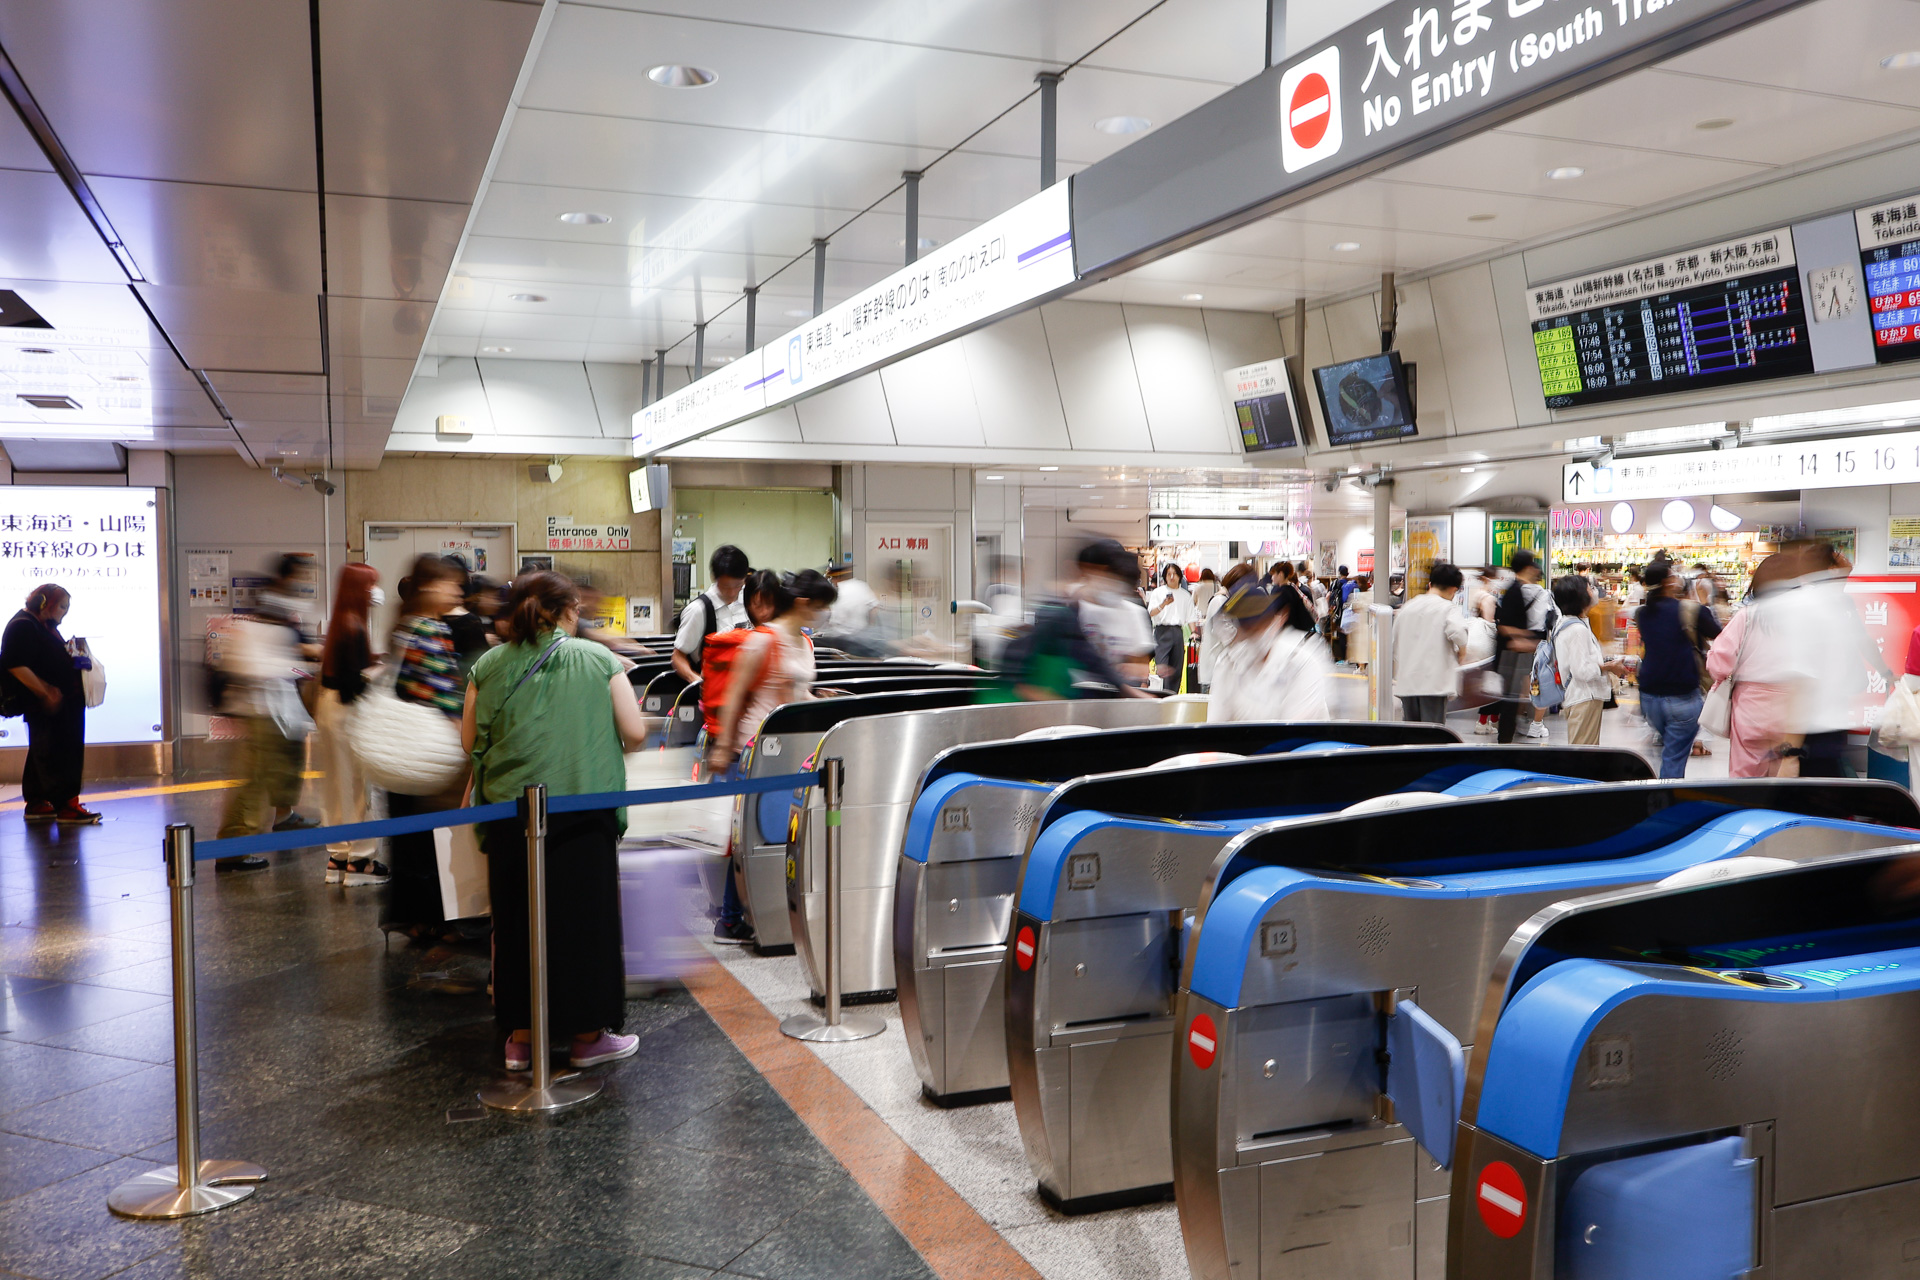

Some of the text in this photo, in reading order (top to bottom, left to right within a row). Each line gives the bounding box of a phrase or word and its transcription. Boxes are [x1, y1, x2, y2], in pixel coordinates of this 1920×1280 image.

[1362, 94, 1401, 137] No
[1410, 50, 1497, 116] Entry
[1509, 6, 1604, 73] (South
[1871, 202, 1918, 227] 東海道
[1593, 287, 1638, 303] Shinkansen
[1579, 335, 1600, 349] 17:48
[1582, 349, 1603, 363] 17:54
[1584, 362, 1605, 376] 18:00
[1586, 376, 1608, 389] 18:09
[1798, 453, 1818, 475] 14
[1835, 450, 1856, 473] 15
[1874, 447, 1895, 470] 16
[0, 514, 146, 532] 東海道・山陽
[547, 526, 629, 538] Entrance Only
[1, 541, 146, 558] 新幹線のりば
[548, 538, 630, 550] 南乗り換え入口
[1079, 863, 1091, 875] 11
[1272, 931, 1288, 945] 12
[1605, 1050, 1623, 1067] 13
